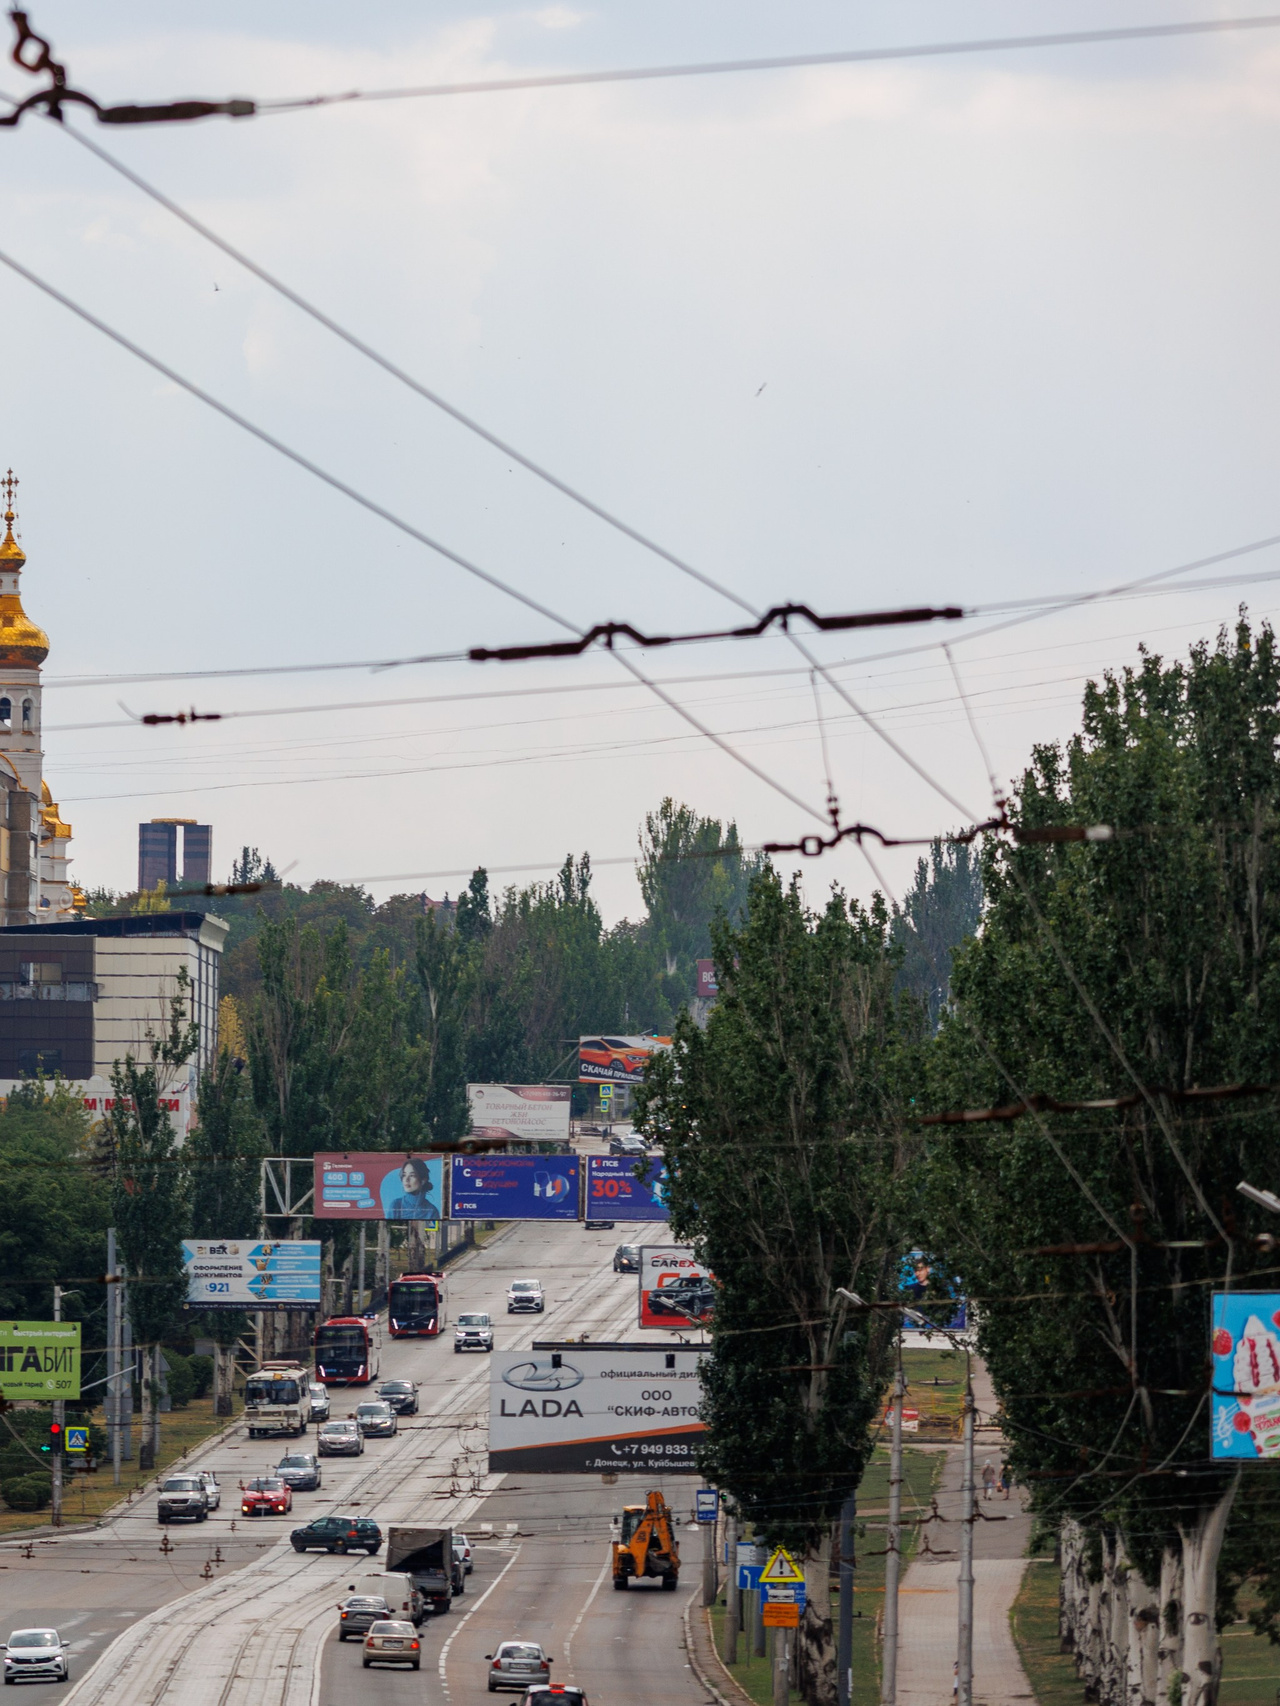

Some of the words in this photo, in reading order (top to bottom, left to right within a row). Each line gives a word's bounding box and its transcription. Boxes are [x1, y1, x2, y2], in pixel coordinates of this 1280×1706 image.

[581, 1063, 613, 1078] СКАЧАЙ
[602, 1160, 619, 1168] ПСБ
[651, 1260, 696, 1268] CAREX
[209, 1283, 230, 1292] 921
[600, 1369, 677, 1379] официальный
[55, 1380, 72, 1389] 507
[500, 1400, 584, 1418] LADA
[622, 1445, 638, 1454] +7
[641, 1445, 663, 1455] 949
[665, 1445, 688, 1455] 833
[648, 1459, 696, 1468] Куйбышев
